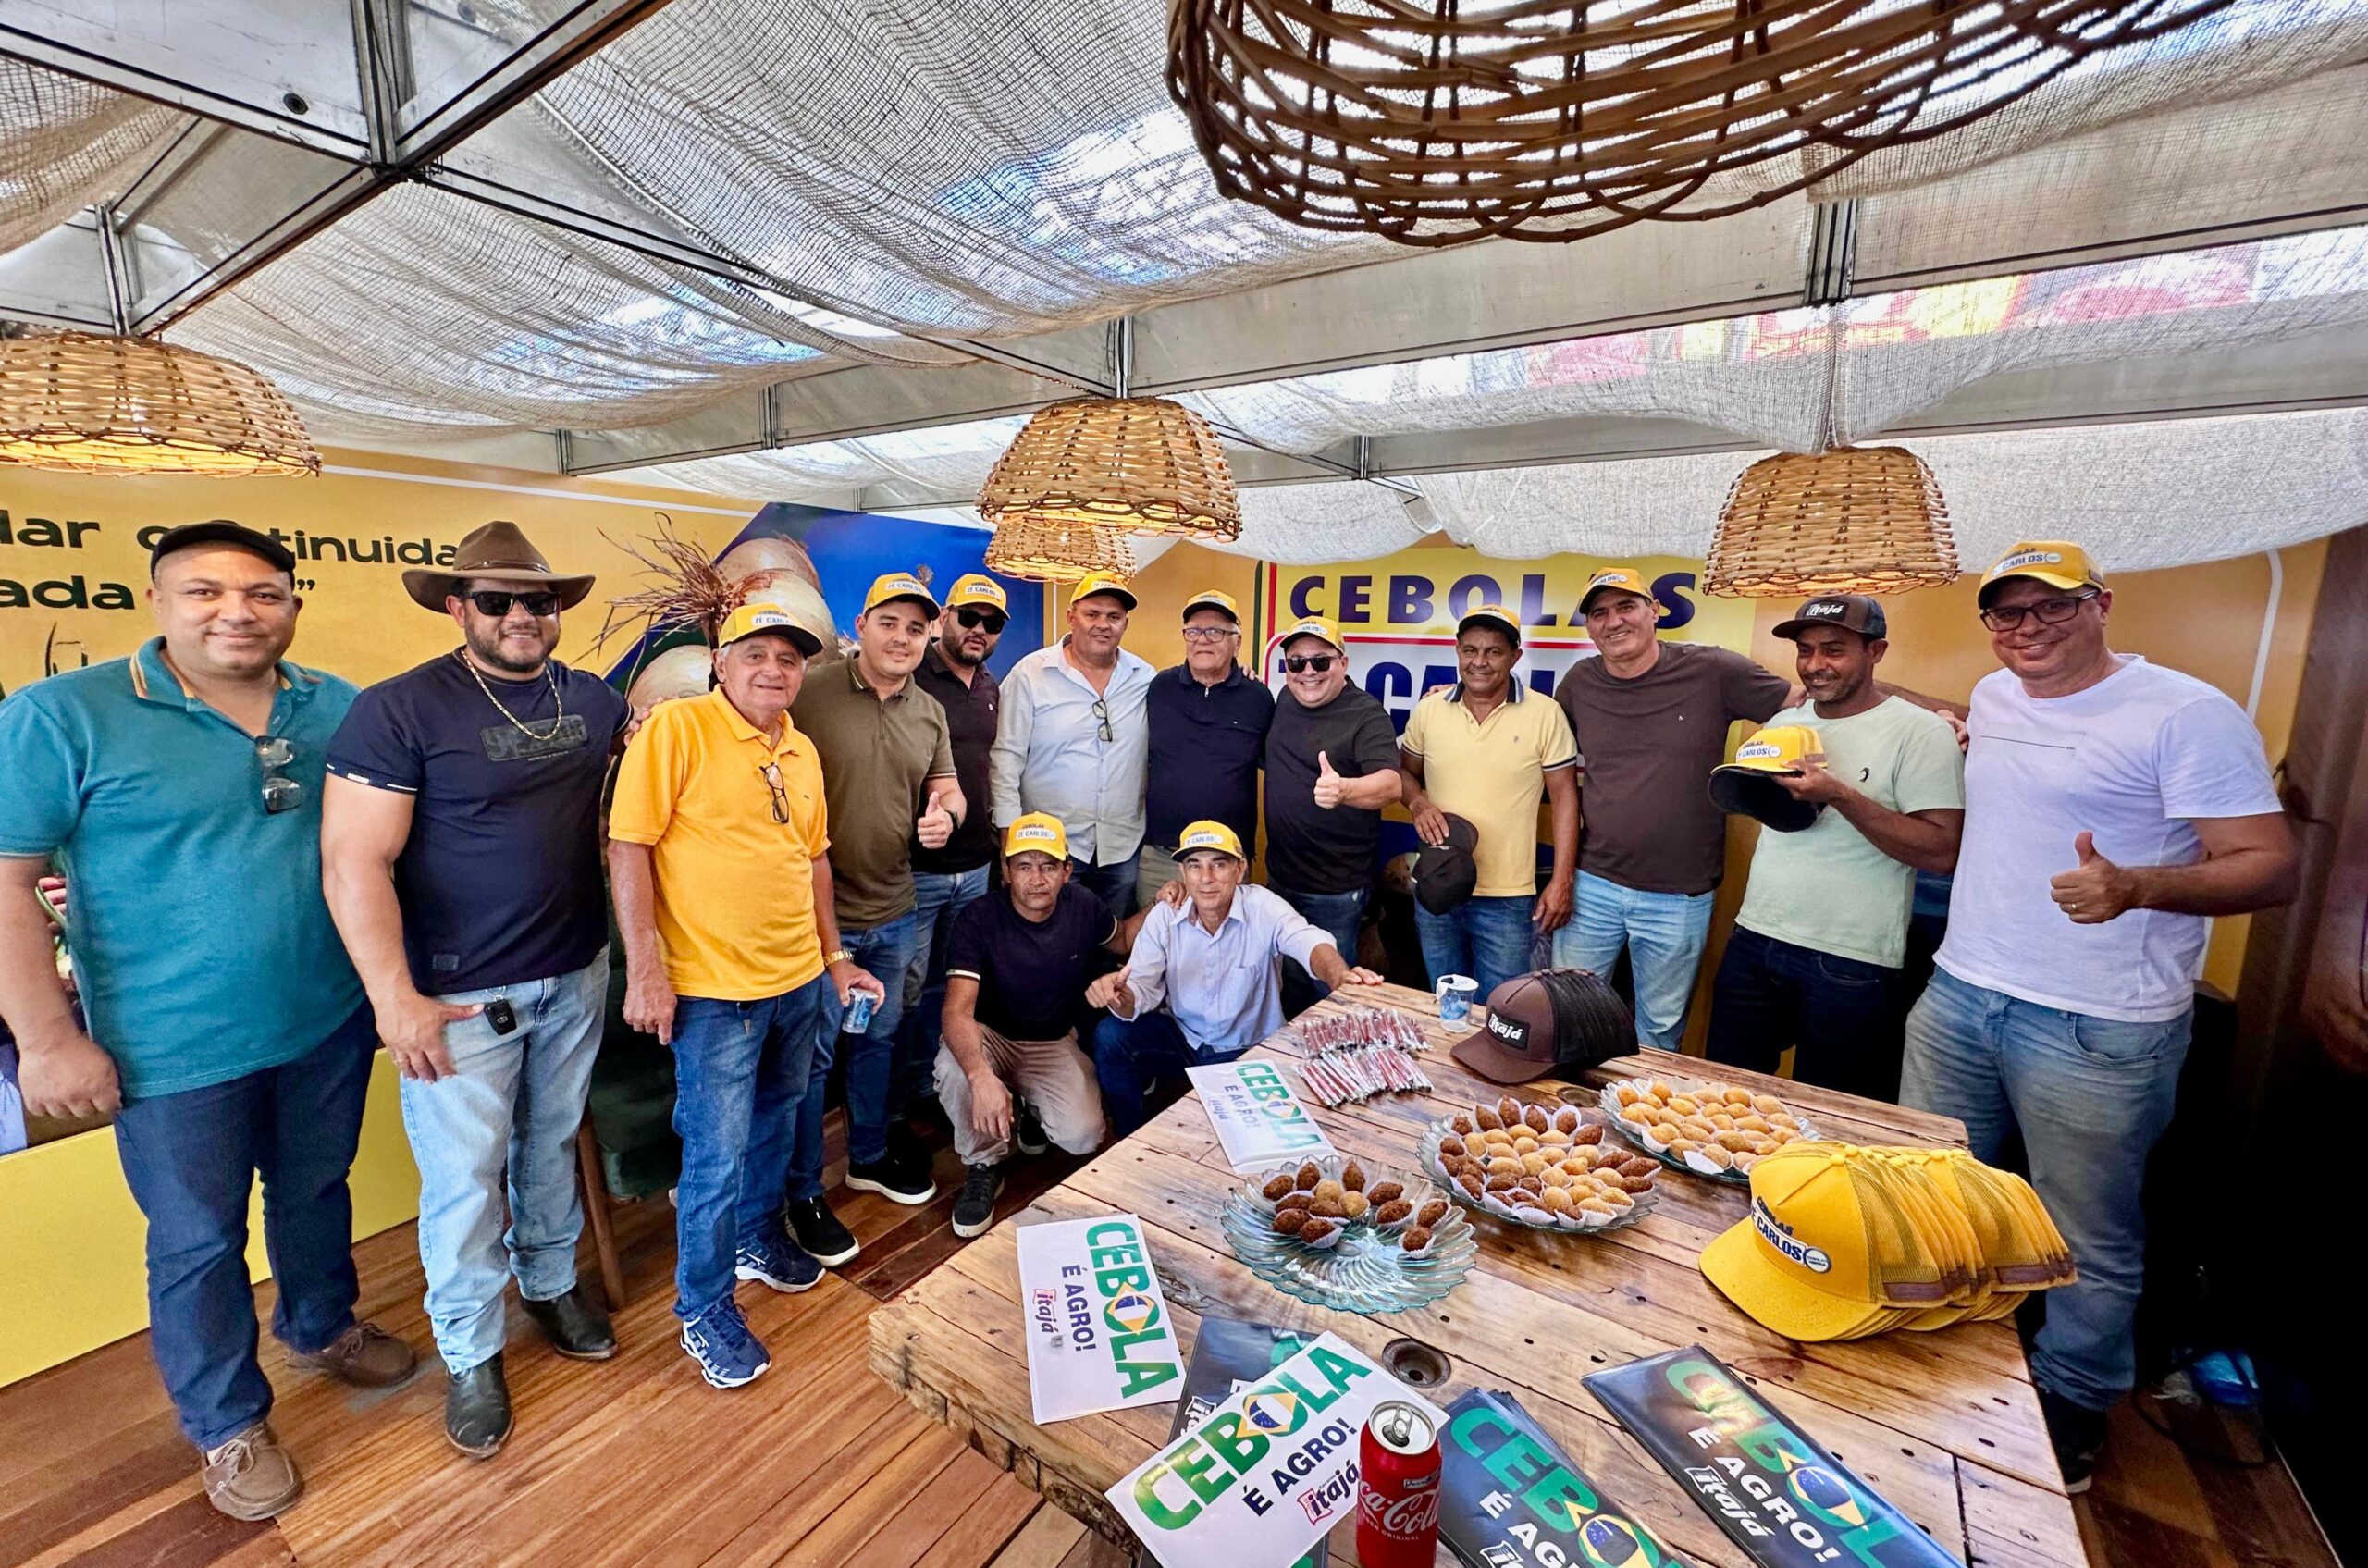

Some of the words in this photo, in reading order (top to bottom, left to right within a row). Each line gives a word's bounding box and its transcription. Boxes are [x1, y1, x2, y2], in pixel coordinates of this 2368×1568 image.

[1289, 571, 1696, 630] CEBOLS
[1757, 1216, 1803, 1261] CARLOS
[1061, 1265, 1088, 1278] É
[1064, 1284, 1097, 1352] AGRO!
[1086, 1222, 1178, 1399] CEBOLA
[1133, 1346, 1373, 1531] CEBOLA
[1242, 1486, 1274, 1517] É
[1270, 1417, 1358, 1496] AGRO!
[1381, 1530, 1420, 1541] ORIGINAL
[1479, 1490, 1513, 1520] É
[1714, 1456, 1841, 1563] AGRO!
